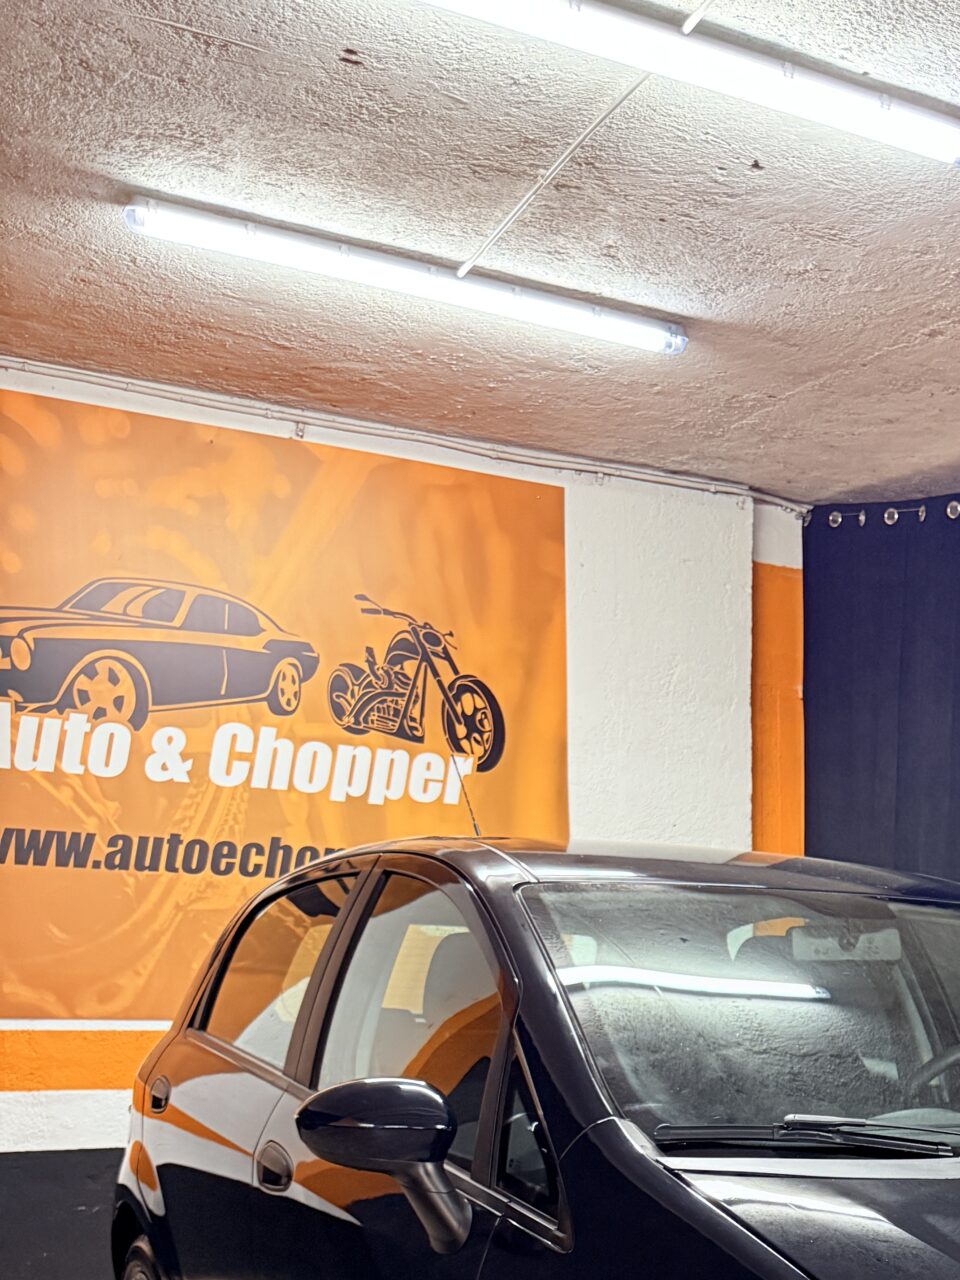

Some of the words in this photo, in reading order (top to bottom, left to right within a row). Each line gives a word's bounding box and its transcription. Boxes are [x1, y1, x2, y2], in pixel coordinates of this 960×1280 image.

[0, 702, 131, 778] uto
[145, 726, 193, 783] &
[208, 722, 474, 805] Chopper
[0, 827, 346, 878] ww.autoecho
